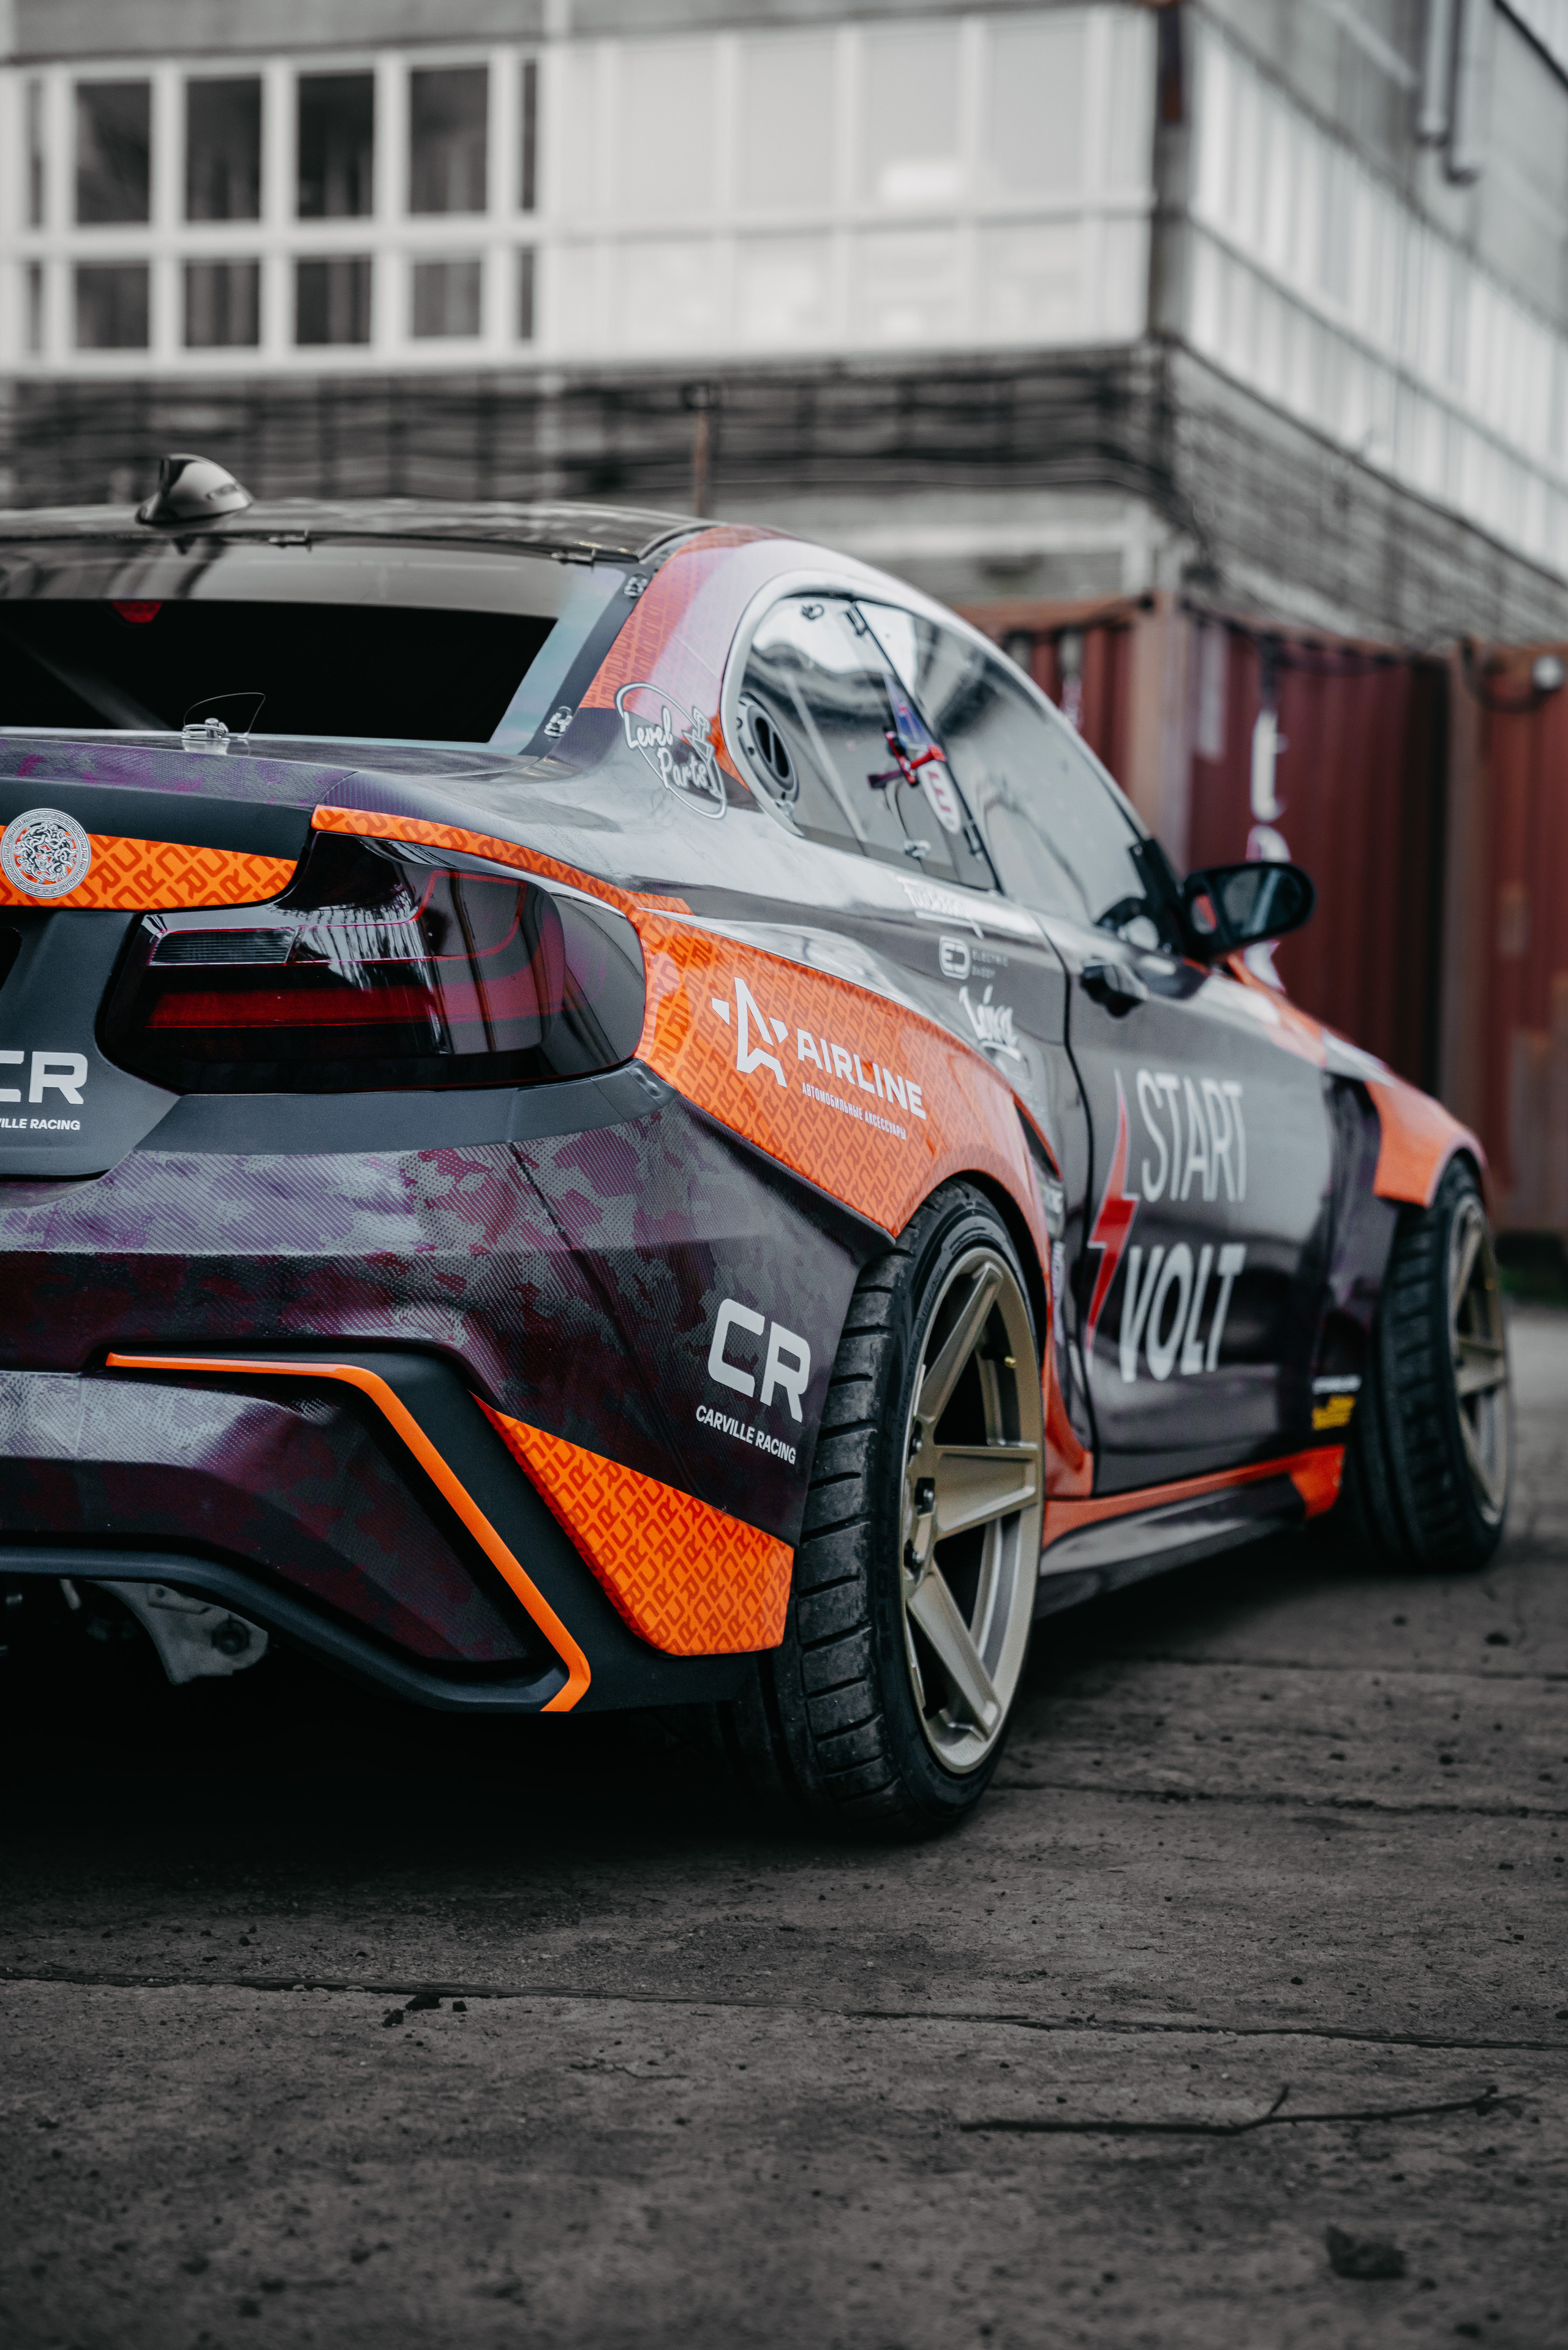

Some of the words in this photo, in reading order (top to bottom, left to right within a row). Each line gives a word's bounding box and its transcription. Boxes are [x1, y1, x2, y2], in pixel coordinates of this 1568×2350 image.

[623, 705, 673, 749] Level
[657, 747, 709, 789] Parts
[796, 1028, 927, 1120] AIRLINE
[29, 1118, 81, 1131] RACING
[802, 1082, 864, 1121] АВТОМОБИЛЬНЫЕ
[864, 1110, 907, 1141] АКСЕССУАРЫ
[1136, 1068, 1248, 1203] START
[1119, 1241, 1248, 1384] VOLT
[707, 1298, 811, 1423] CR
[695, 1405, 756, 1444] CARVILLE
[755, 1430, 797, 1466] RACING
